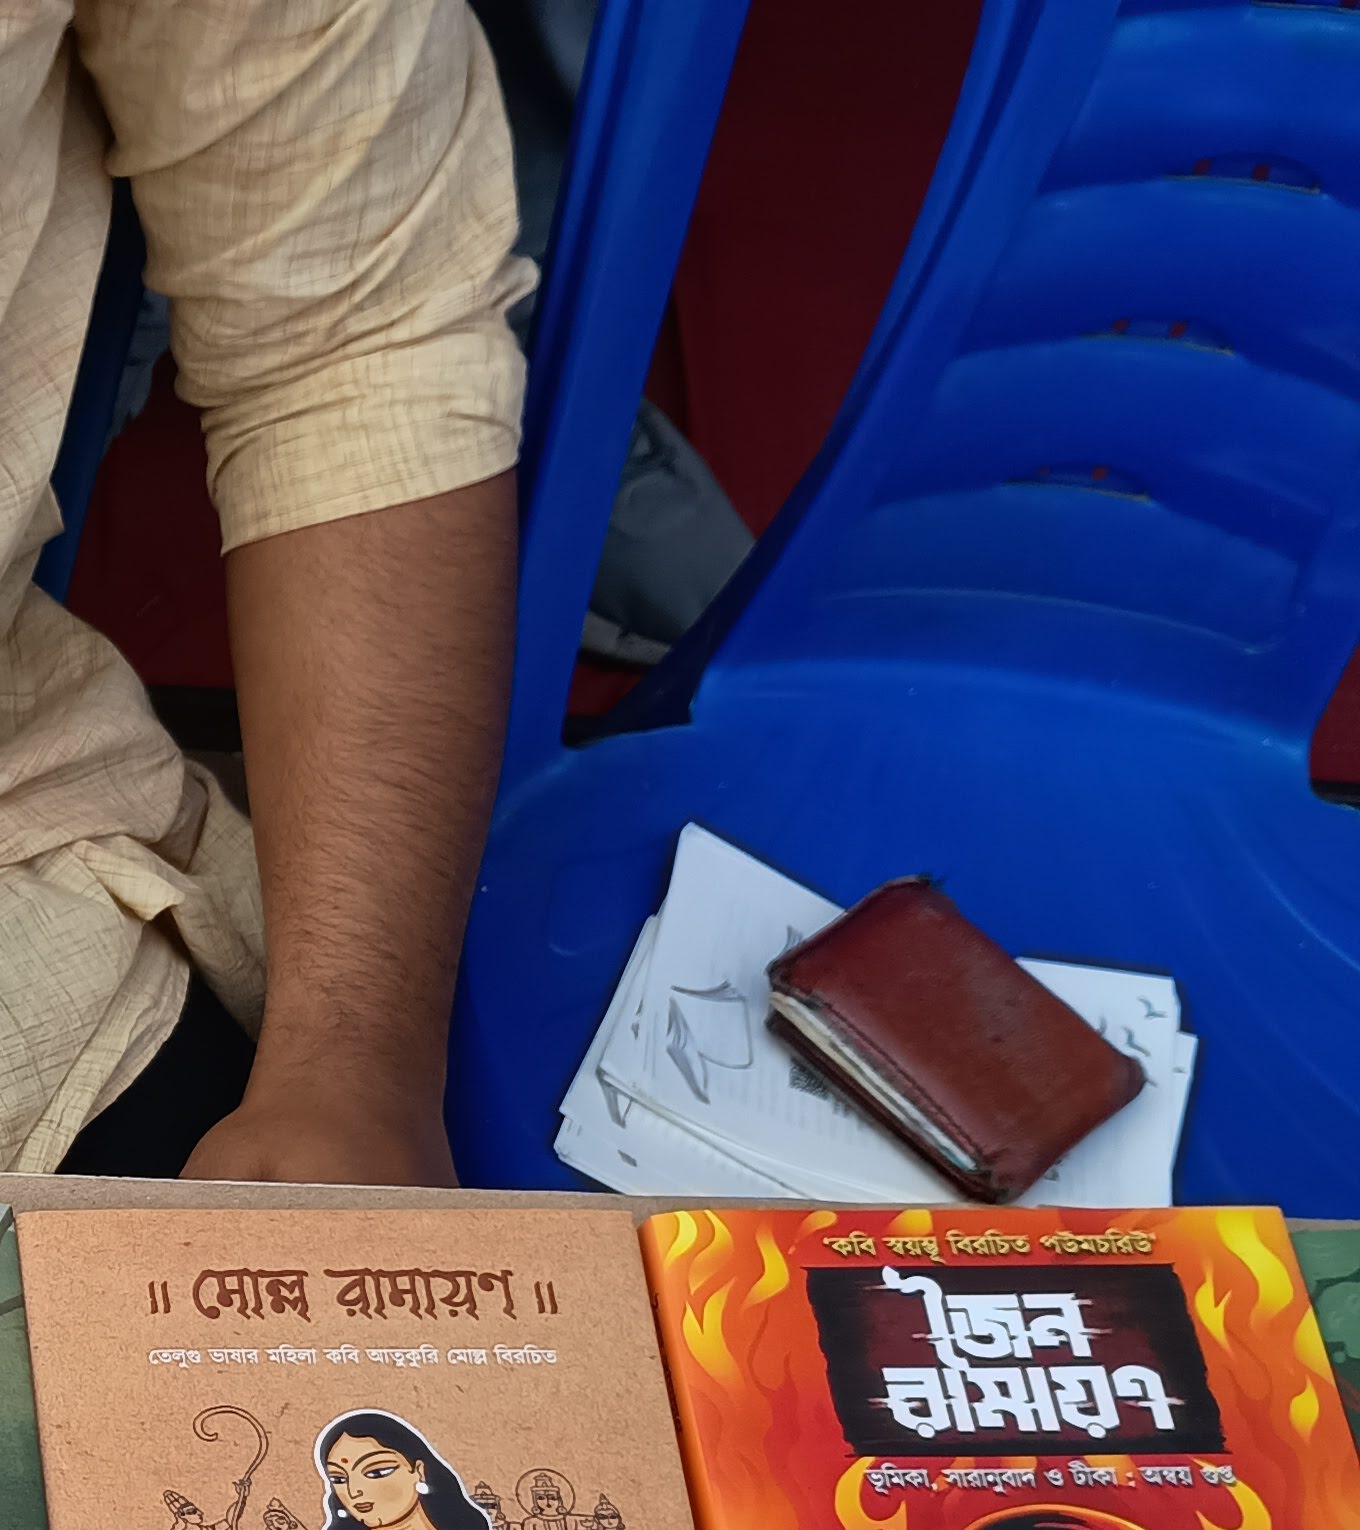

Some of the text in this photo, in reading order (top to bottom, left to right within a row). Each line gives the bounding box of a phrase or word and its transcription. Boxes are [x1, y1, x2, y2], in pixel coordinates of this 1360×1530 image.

[946, 1229, 1031, 1255] বিরচিত
[324, 1267, 517, 1320] রামায়ণ
[882, 1265, 1093, 1369] জৈন
[208, 1347, 260, 1365] ভাষার
[266, 1344, 317, 1364] মহিলা
[326, 1344, 359, 1364] কবি
[494, 1344, 557, 1365] বিরচিত
[882, 1364, 1176, 1438] রামায়ণ
[1044, 1470, 1063, 1486] ও
[1068, 1460, 1118, 1485] টীকা
